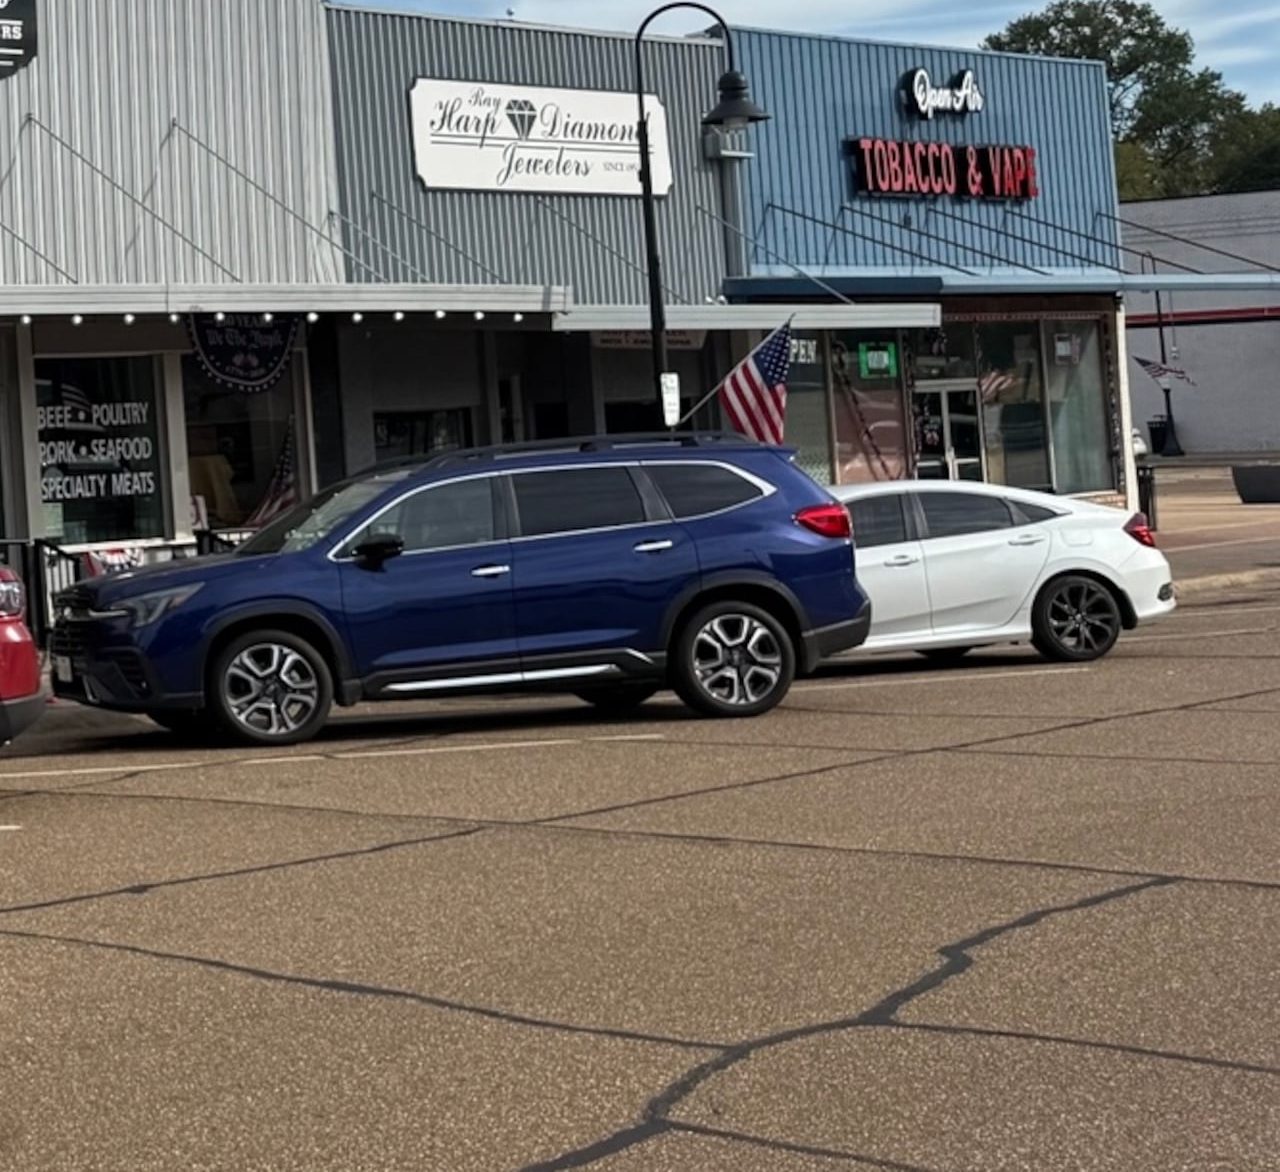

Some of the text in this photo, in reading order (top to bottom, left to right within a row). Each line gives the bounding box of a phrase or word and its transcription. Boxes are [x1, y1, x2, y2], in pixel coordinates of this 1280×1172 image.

[468, 87, 501, 115] Ray
[913, 68, 984, 119] Open Air
[430, 98, 500, 148] Harp
[496, 143, 593, 186] Jewelers
[860, 139, 1039, 197] TOBACCO & VAPE
[790, 339, 817, 364] PEN
[38, 402, 149, 430] BEEF POULTRY
[39, 436, 153, 465] PORK SEAFOOD
[41, 471, 156, 500] SPECIALTY MEATS
